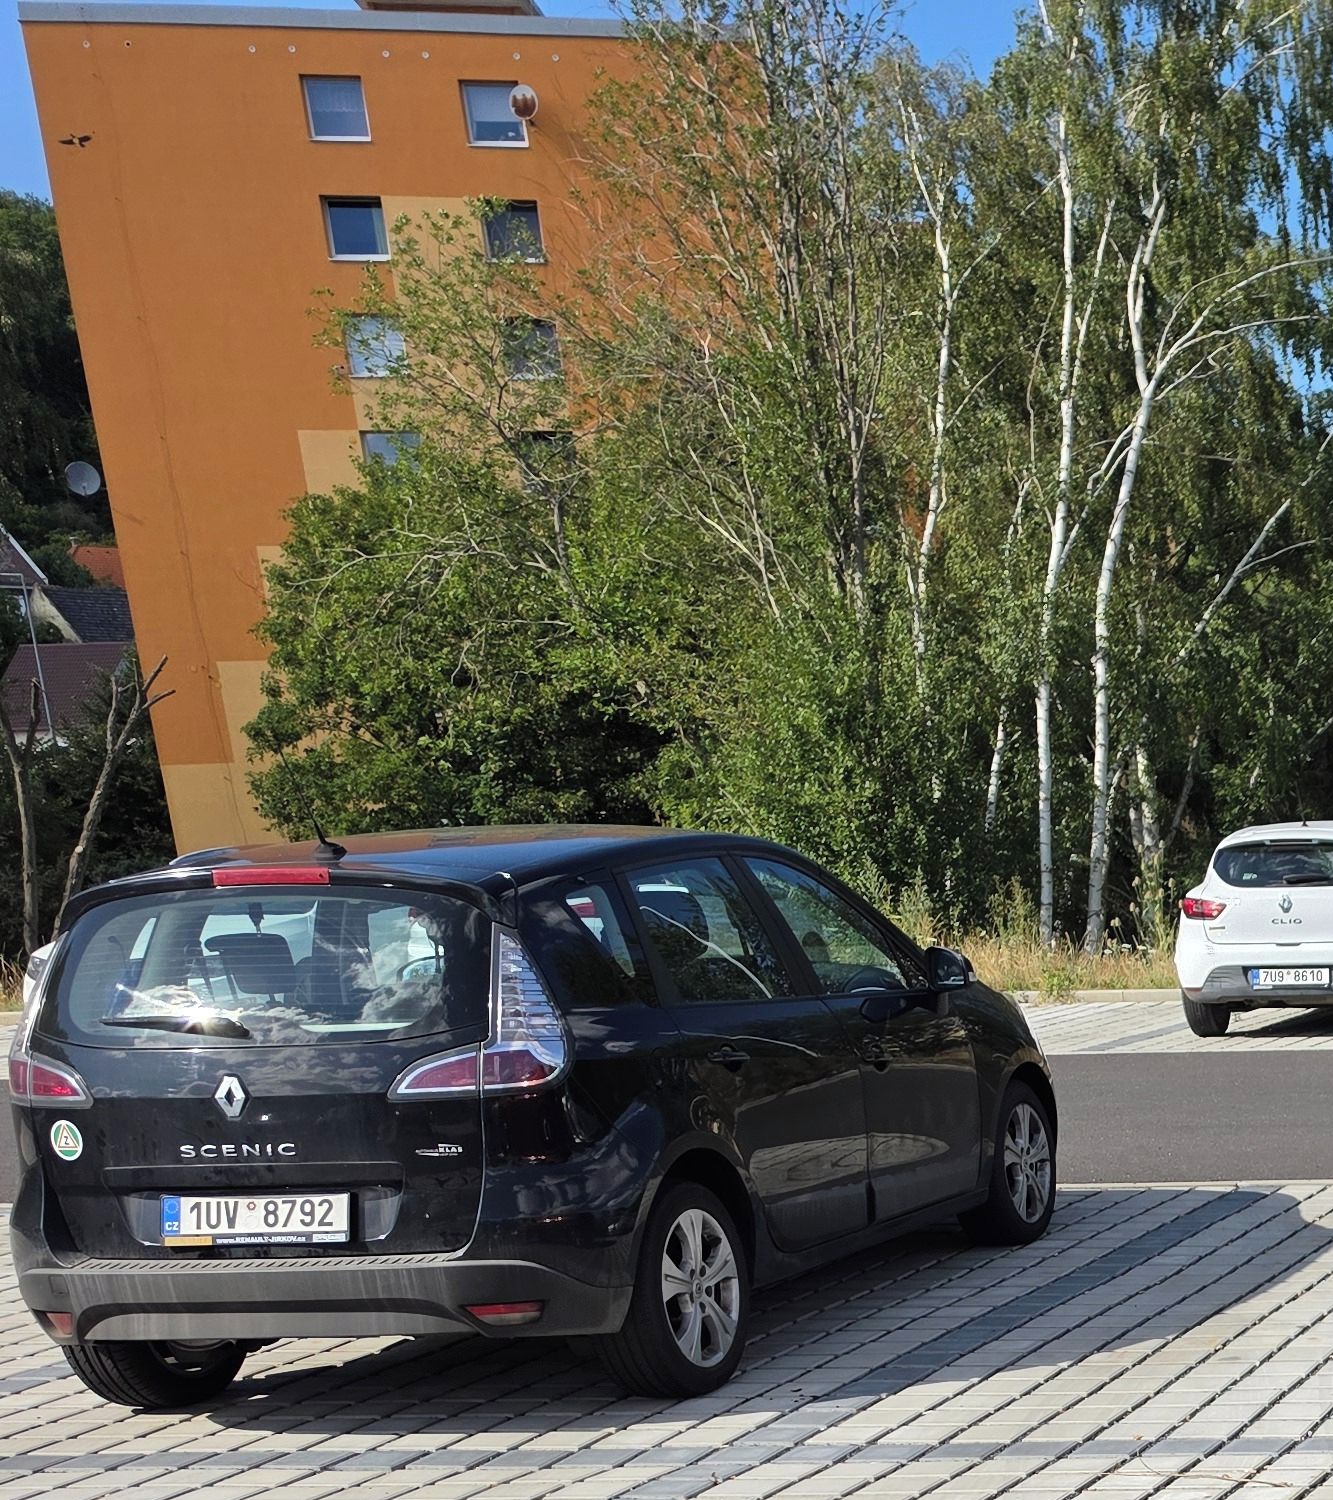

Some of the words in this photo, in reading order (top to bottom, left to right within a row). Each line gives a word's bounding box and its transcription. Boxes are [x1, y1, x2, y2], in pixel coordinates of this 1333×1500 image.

[1262, 970, 1284, 983] 7U9
[1293, 969, 1323, 982] 8610
[179, 1143, 296, 1158] SCENIC
[165, 1221, 179, 1231] CZ
[189, 1200, 239, 1230] 1UV
[263, 1198, 334, 1228] 8792
